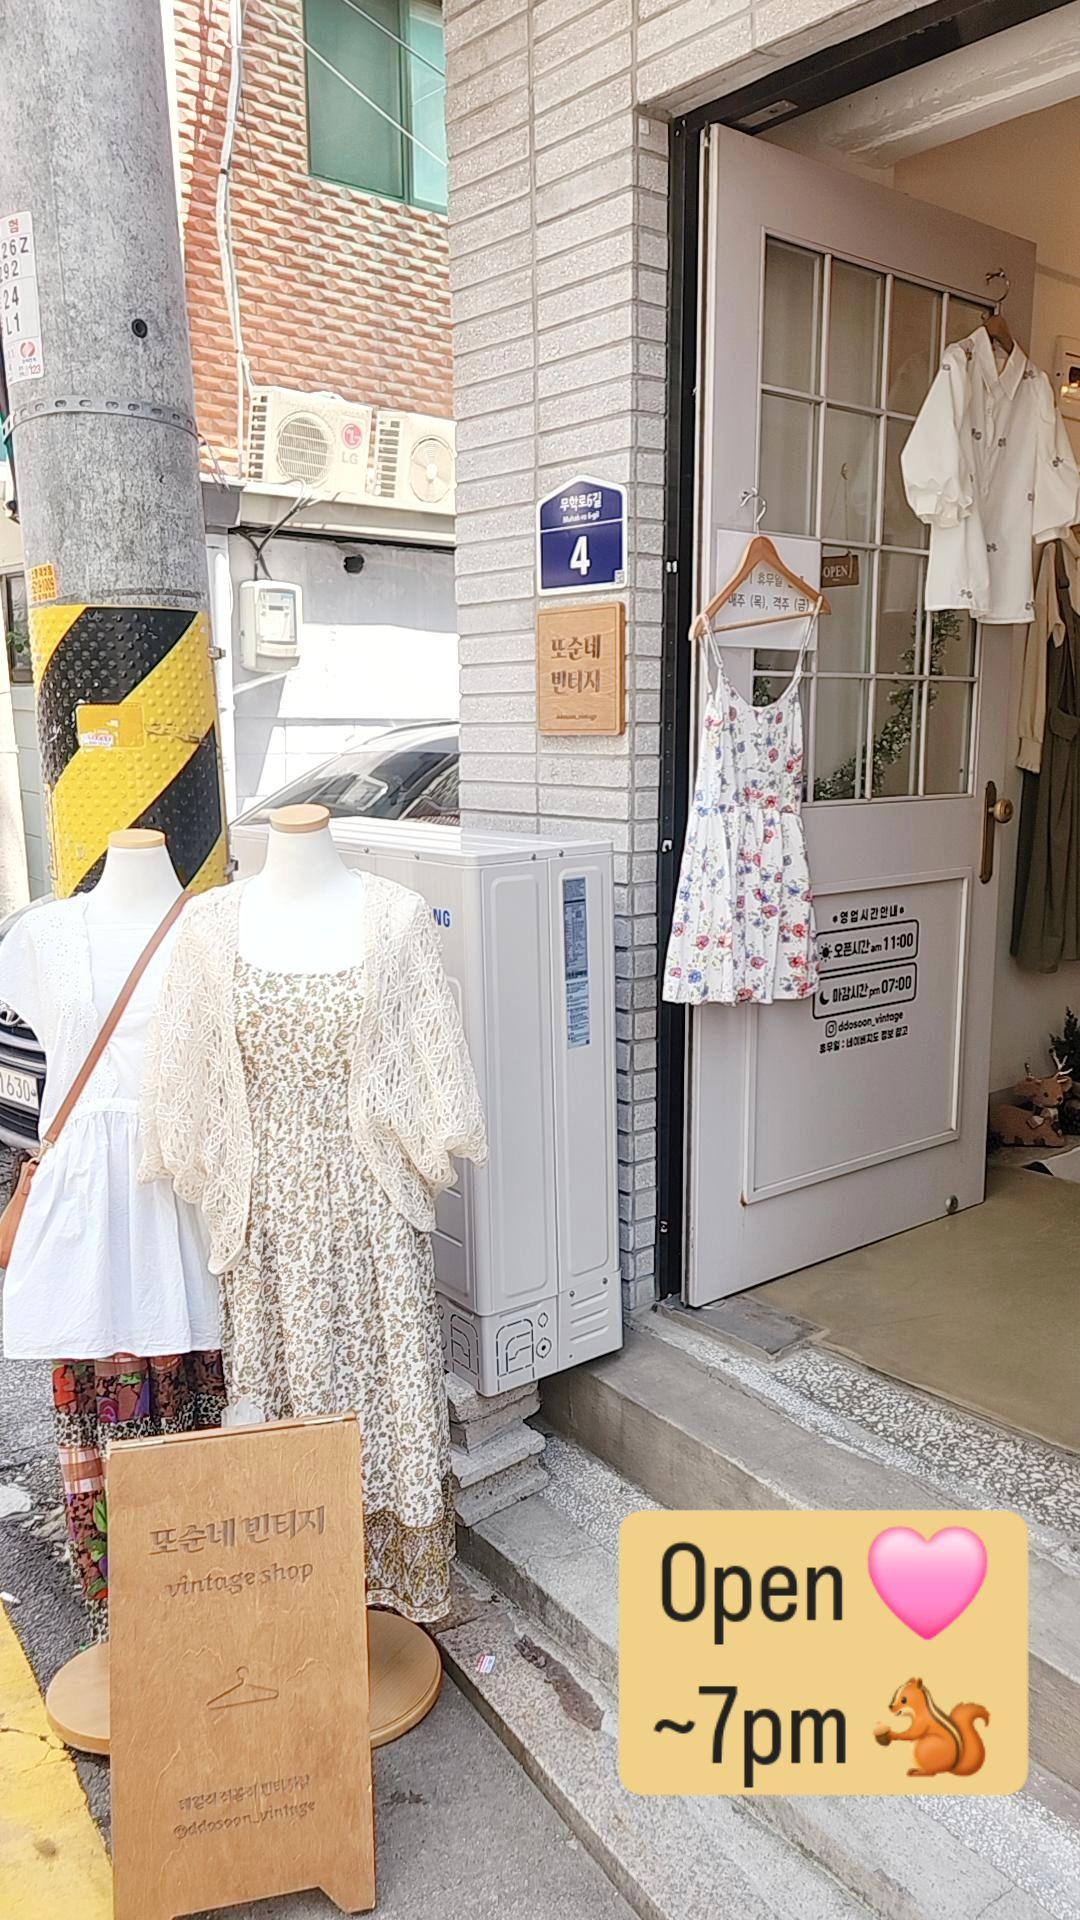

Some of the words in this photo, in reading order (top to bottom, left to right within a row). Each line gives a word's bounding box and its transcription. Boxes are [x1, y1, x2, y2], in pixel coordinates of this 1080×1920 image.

[341, 451, 358, 464] LG
[569, 535, 591, 576] 4
[757, 573, 784, 587] 휴무일
[823, 565, 849, 579] OPEN
[551, 633, 601, 661] 또순네
[551, 670, 601, 695] 빈티지
[834, 939, 870, 958] 오픈시간
[884, 932, 913, 950] 11:00
[832, 983, 868, 1003] 마감시간
[881, 975, 912, 994] 07:00
[148, 1517, 236, 1557] 또순네
[244, 1504, 326, 1545] 빈티지
[165, 1569, 256, 1598] vintage
[259, 1560, 314, 1587] shop
